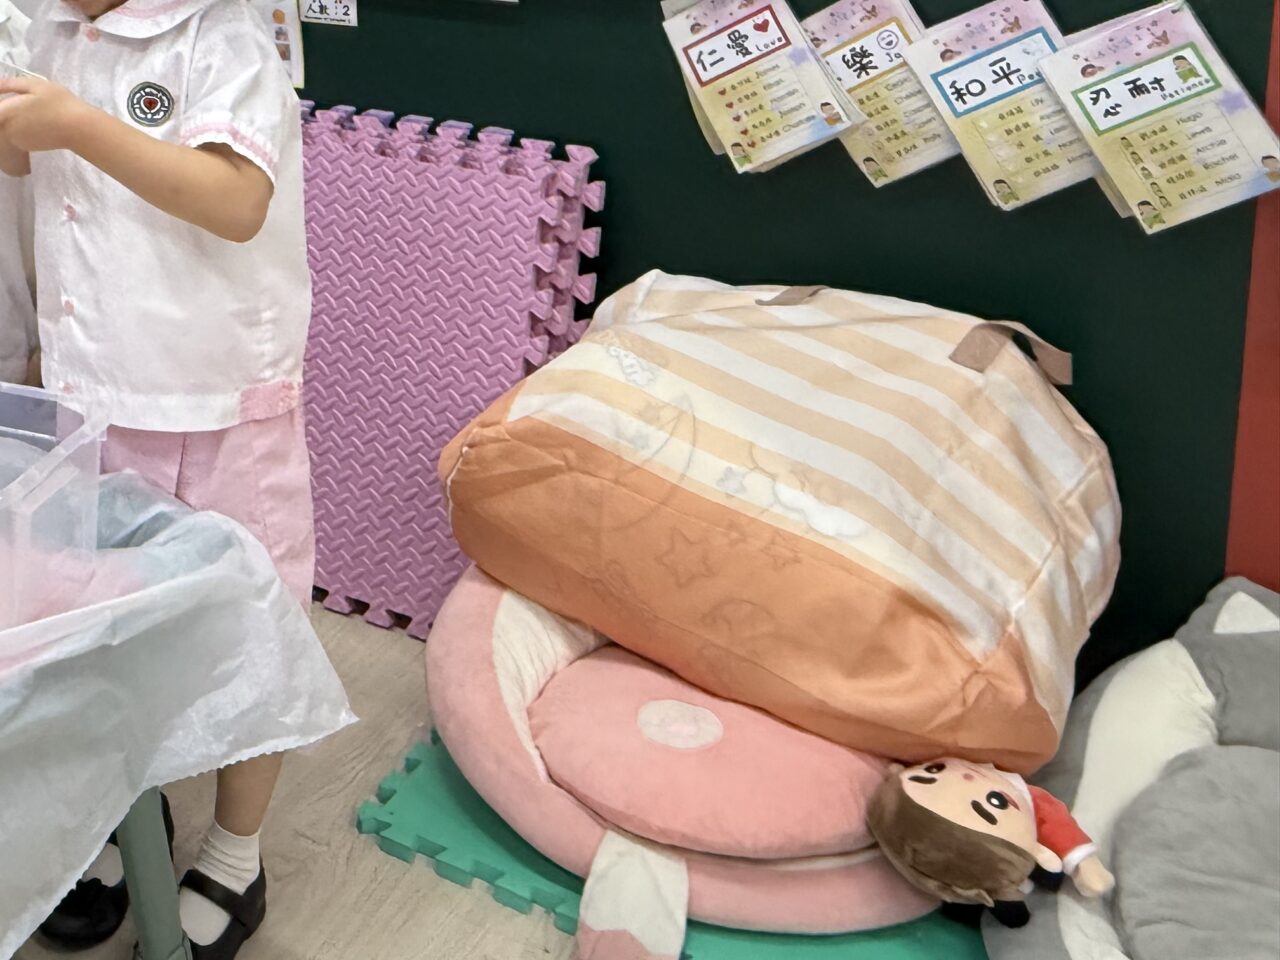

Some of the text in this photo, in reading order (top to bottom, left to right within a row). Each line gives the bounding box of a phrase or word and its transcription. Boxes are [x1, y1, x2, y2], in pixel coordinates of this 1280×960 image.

[756, 36, 783, 52] Love
[886, 52, 903, 63] Jo
[840, 45, 879, 79] 樂
[949, 57, 1021, 105] 和平
[1089, 76, 1165, 119] 忍耐
